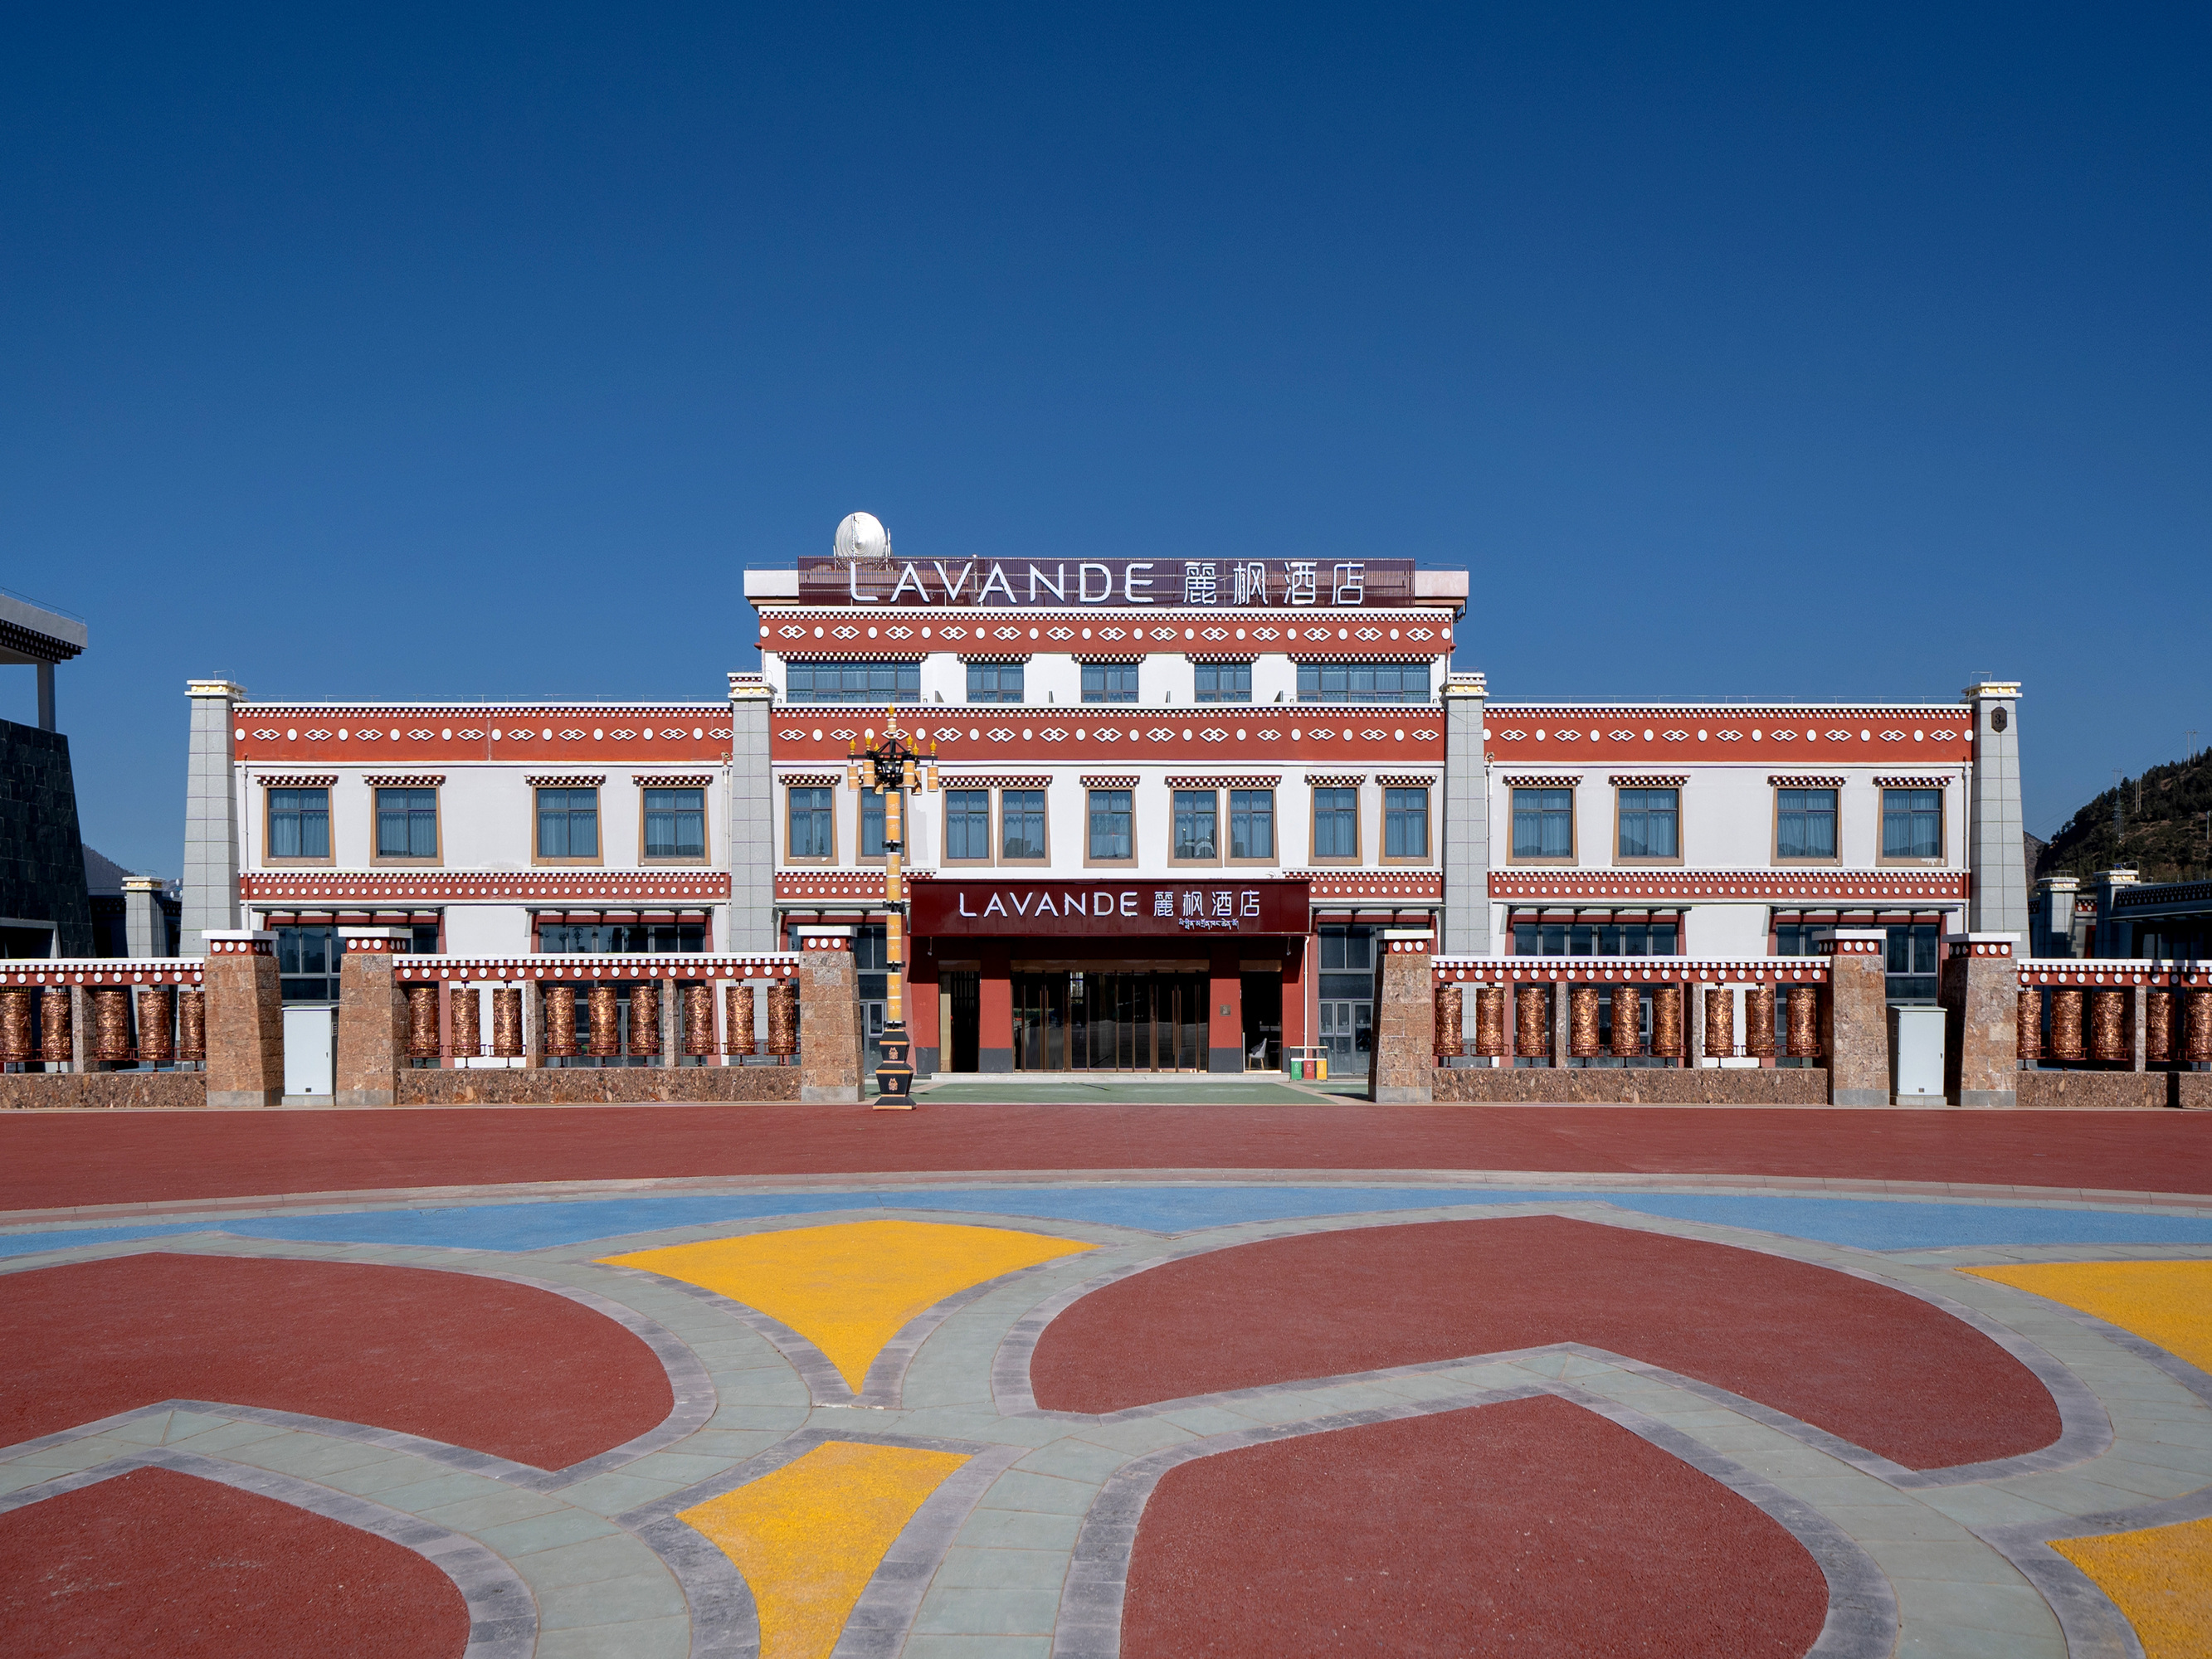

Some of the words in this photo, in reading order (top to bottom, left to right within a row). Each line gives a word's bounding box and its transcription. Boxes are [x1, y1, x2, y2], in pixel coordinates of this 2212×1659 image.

[850, 561, 1155, 604] LAVANDE
[1183, 562, 1366, 606] 麗枫酒店
[958, 891, 1138, 918] LAVANDE
[1153, 889, 1260, 917] 麗枫酒店
